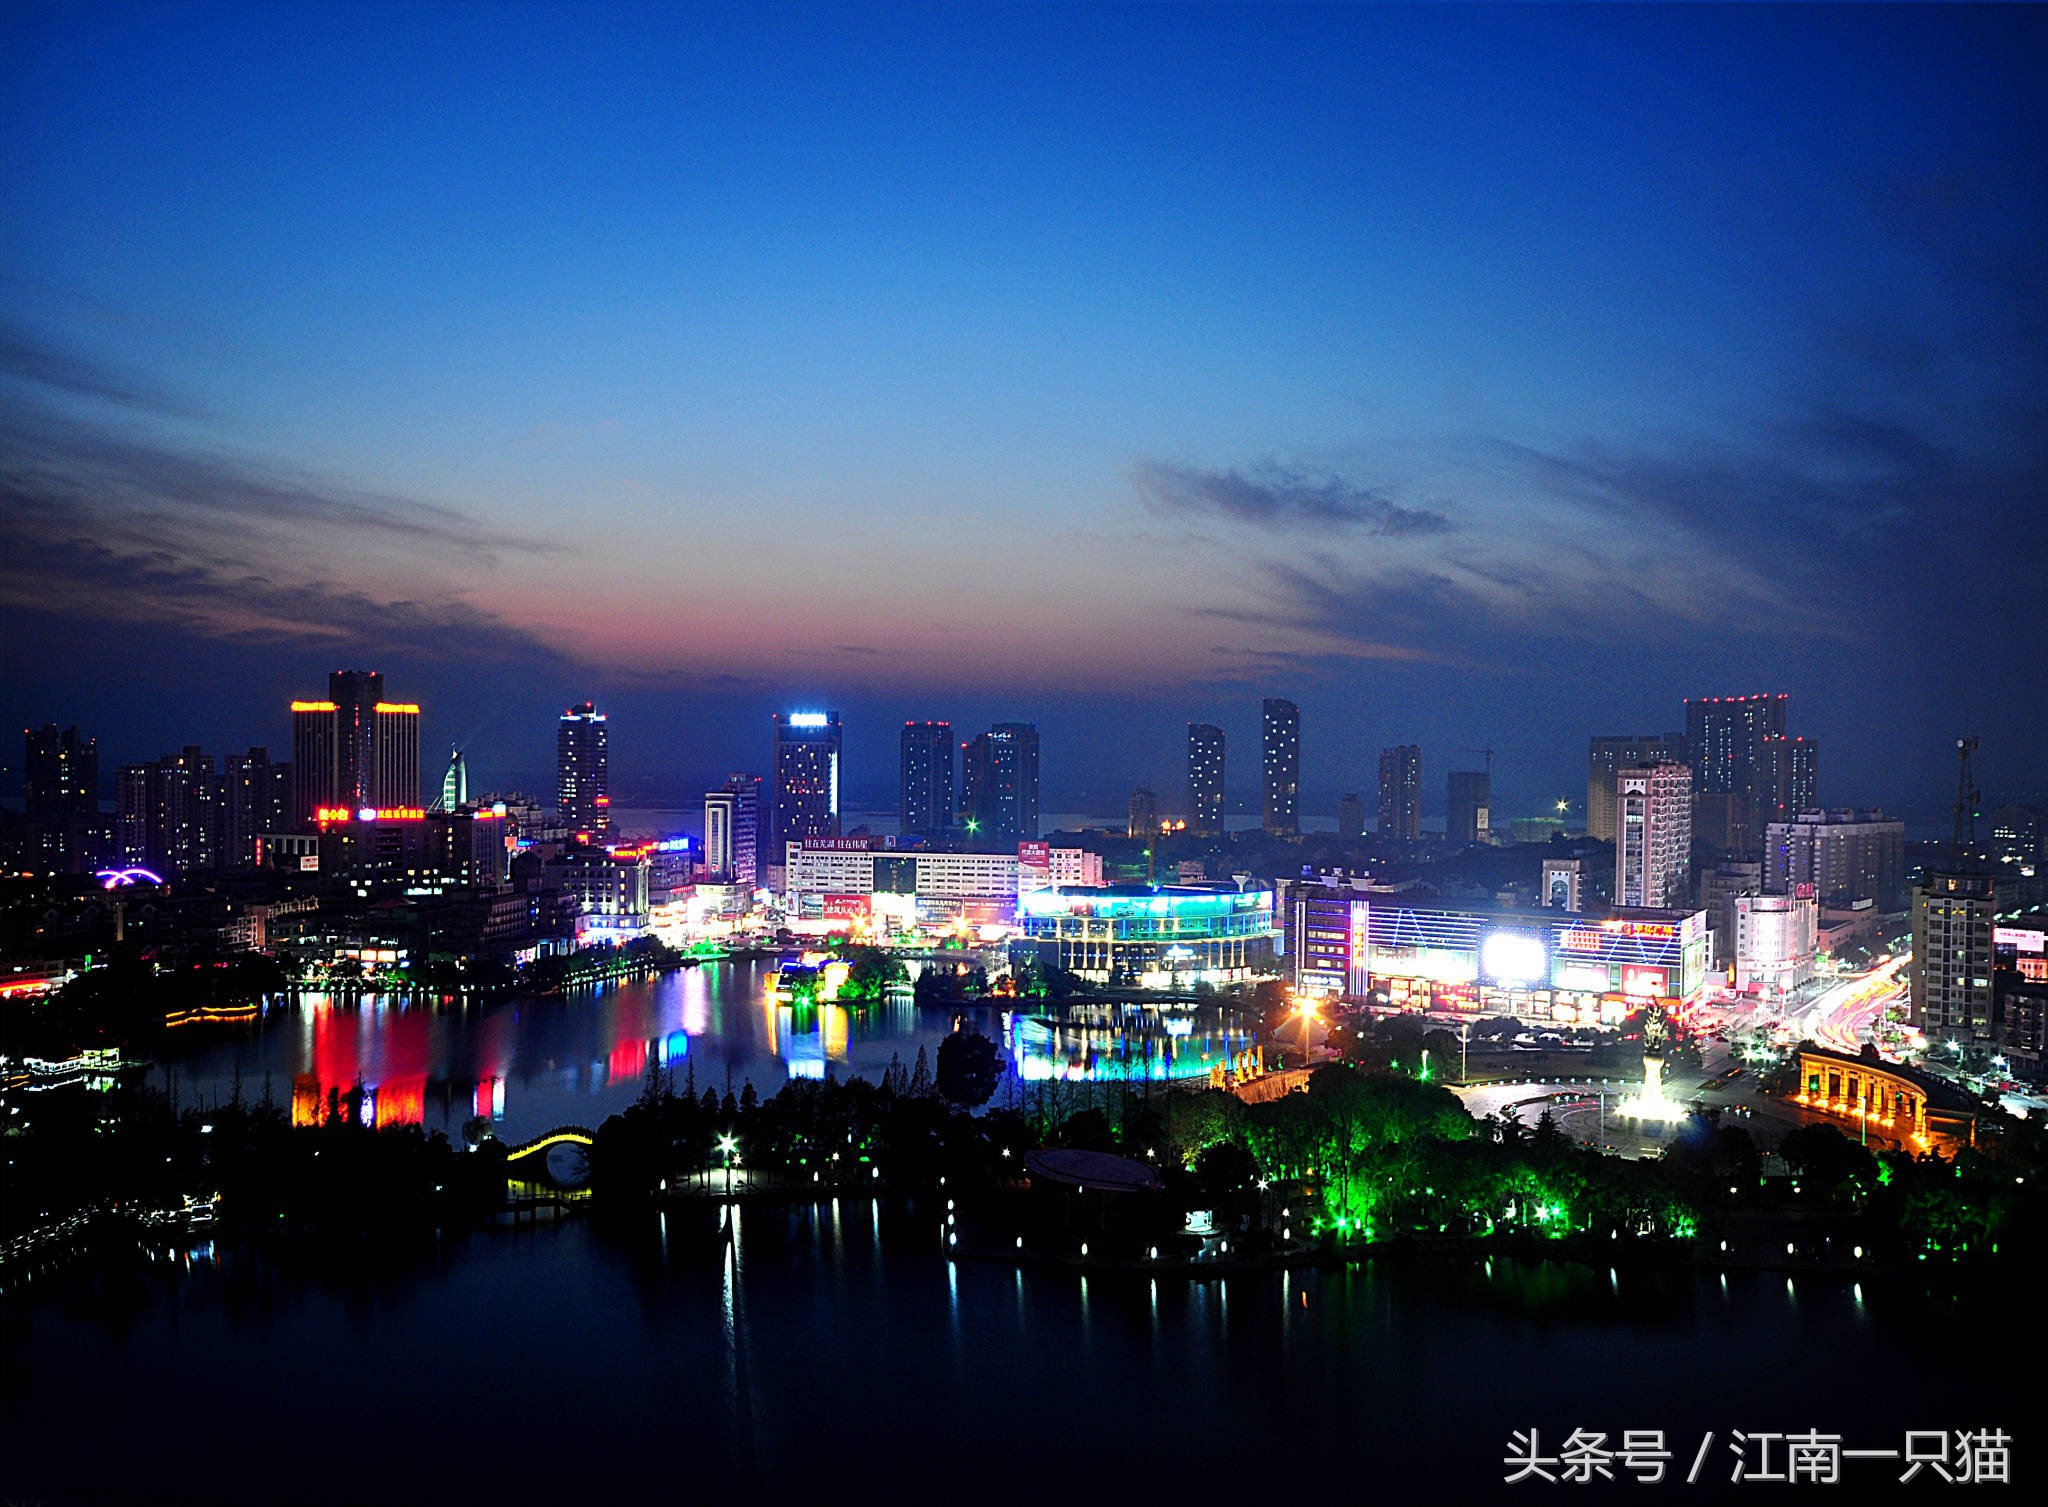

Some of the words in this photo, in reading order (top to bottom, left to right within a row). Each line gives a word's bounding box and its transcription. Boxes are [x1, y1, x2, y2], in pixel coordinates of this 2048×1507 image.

[804, 839, 835, 849] 住在芜湖
[837, 839, 868, 849] 住在伟星
